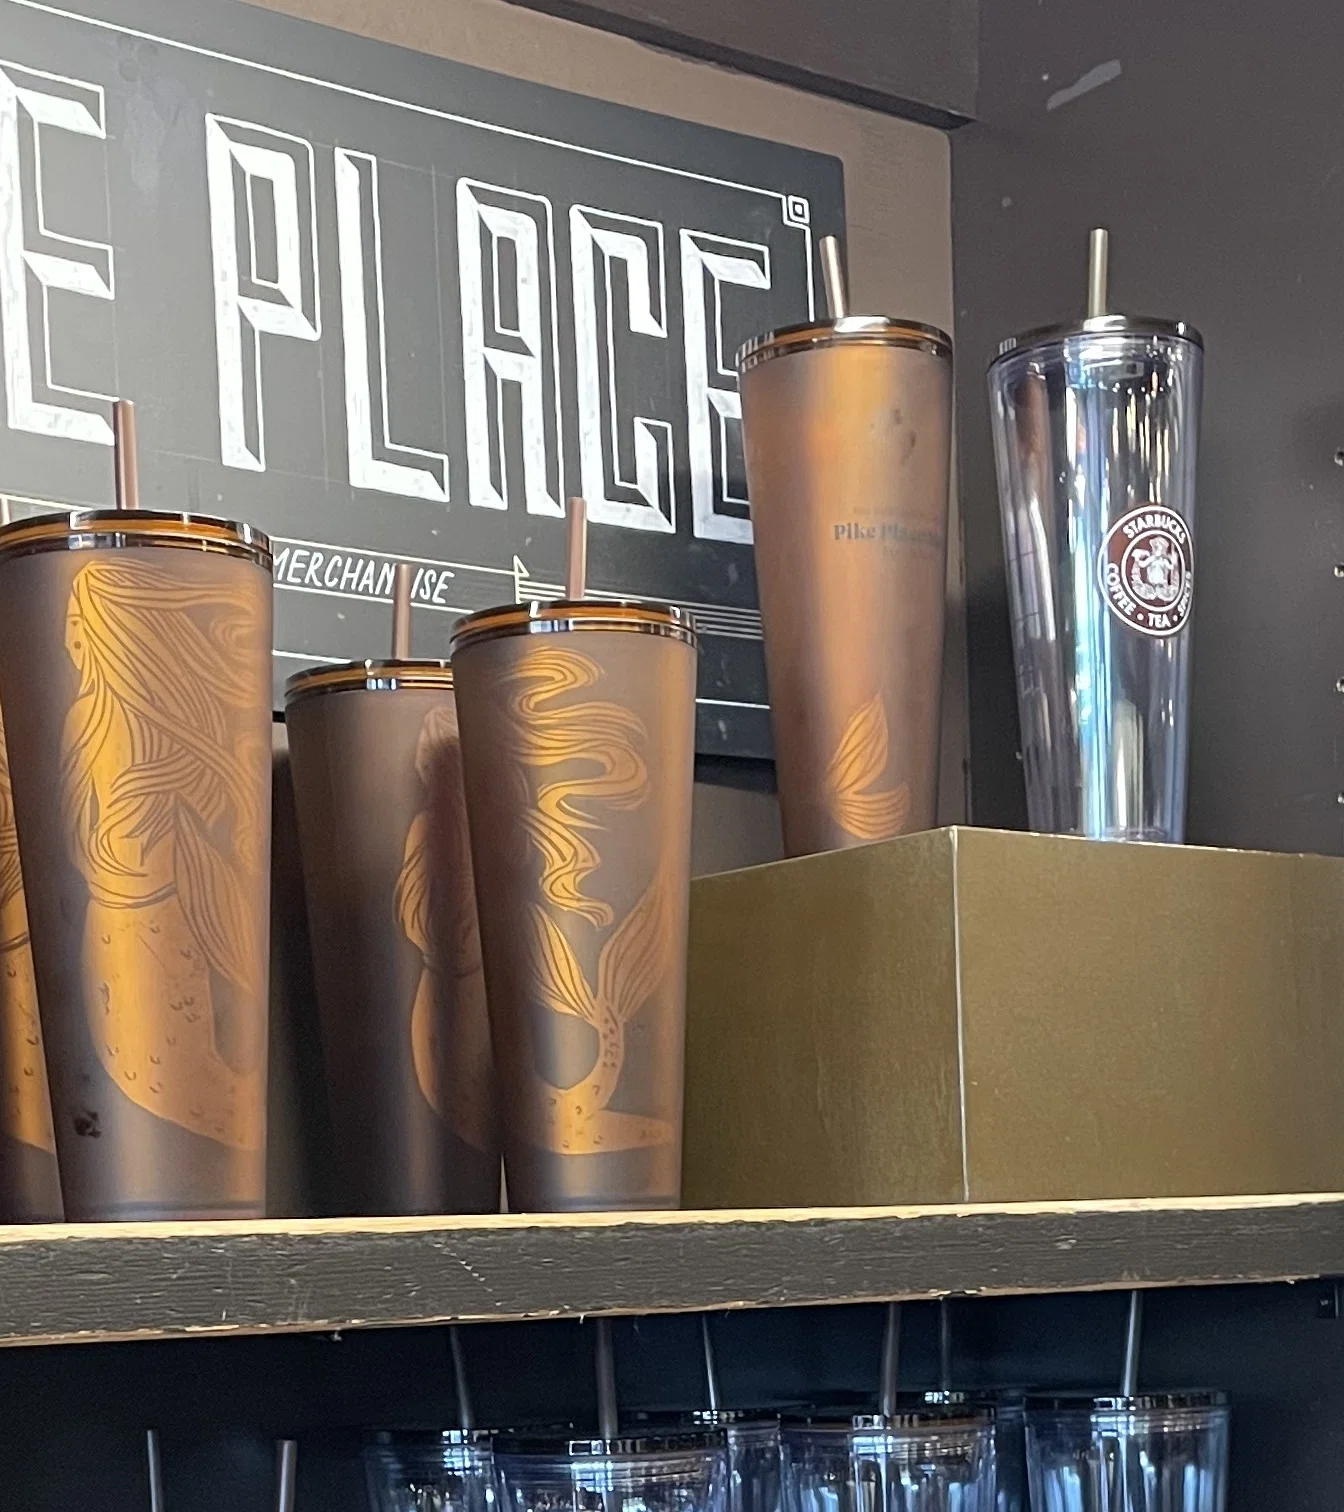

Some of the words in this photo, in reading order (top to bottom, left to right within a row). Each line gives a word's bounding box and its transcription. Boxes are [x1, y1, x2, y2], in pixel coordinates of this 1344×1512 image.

[205, 112, 771, 539] PLACE
[834, 522, 878, 542] Pike
[1123, 514, 1186, 545] STARBUCKS
[273, 546, 455, 604] MERCHANISE
[1107, 563, 1137, 616] COFFEE
[1149, 613, 1171, 628] TEA
